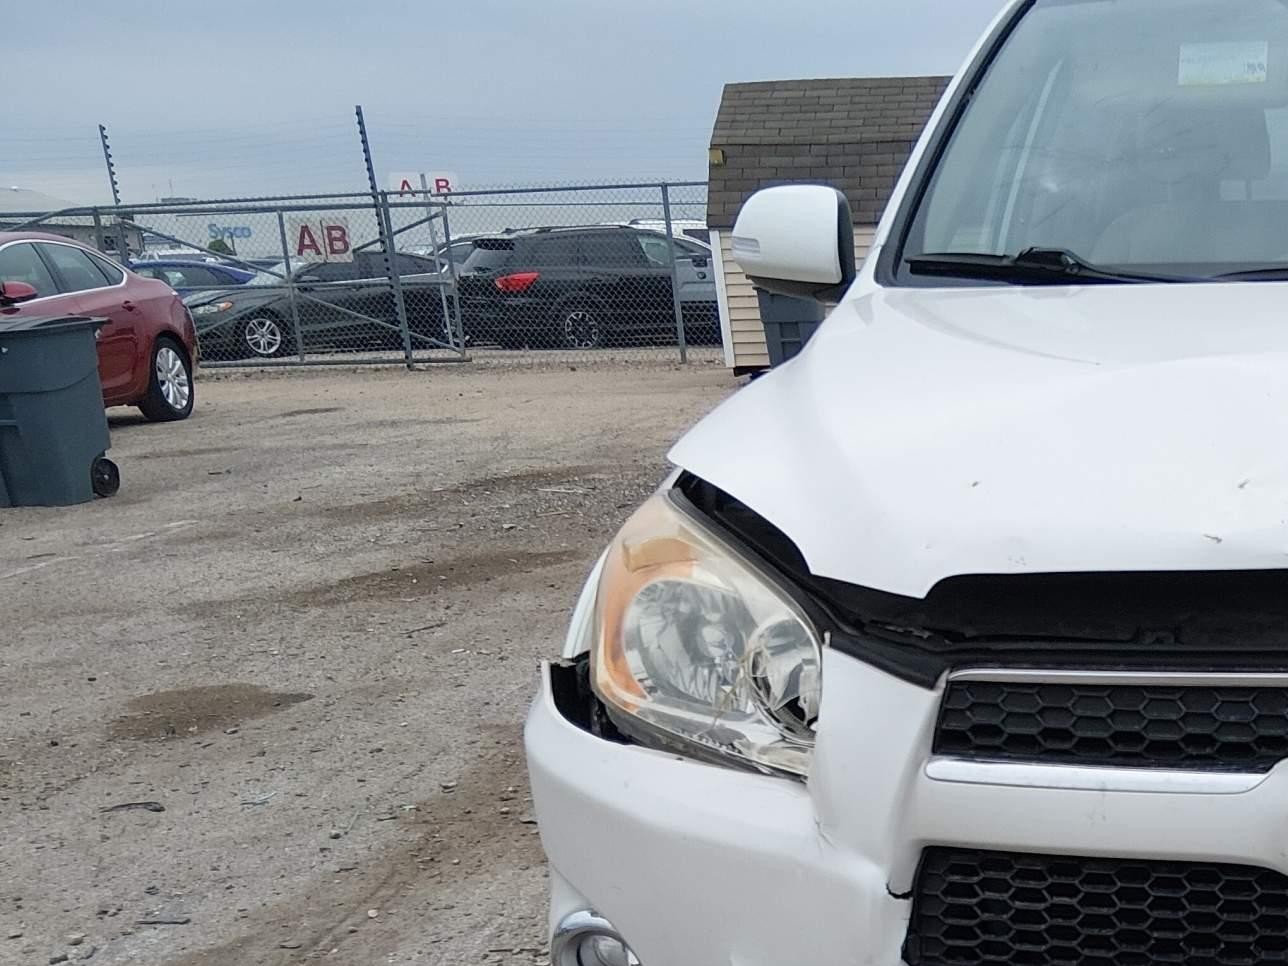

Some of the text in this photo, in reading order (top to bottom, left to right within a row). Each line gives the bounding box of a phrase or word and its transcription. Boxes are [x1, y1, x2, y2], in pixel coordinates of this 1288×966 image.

[400, 178, 451, 197] A B
[207, 223, 252, 239] Sysco
[297, 224, 350, 256] A B
